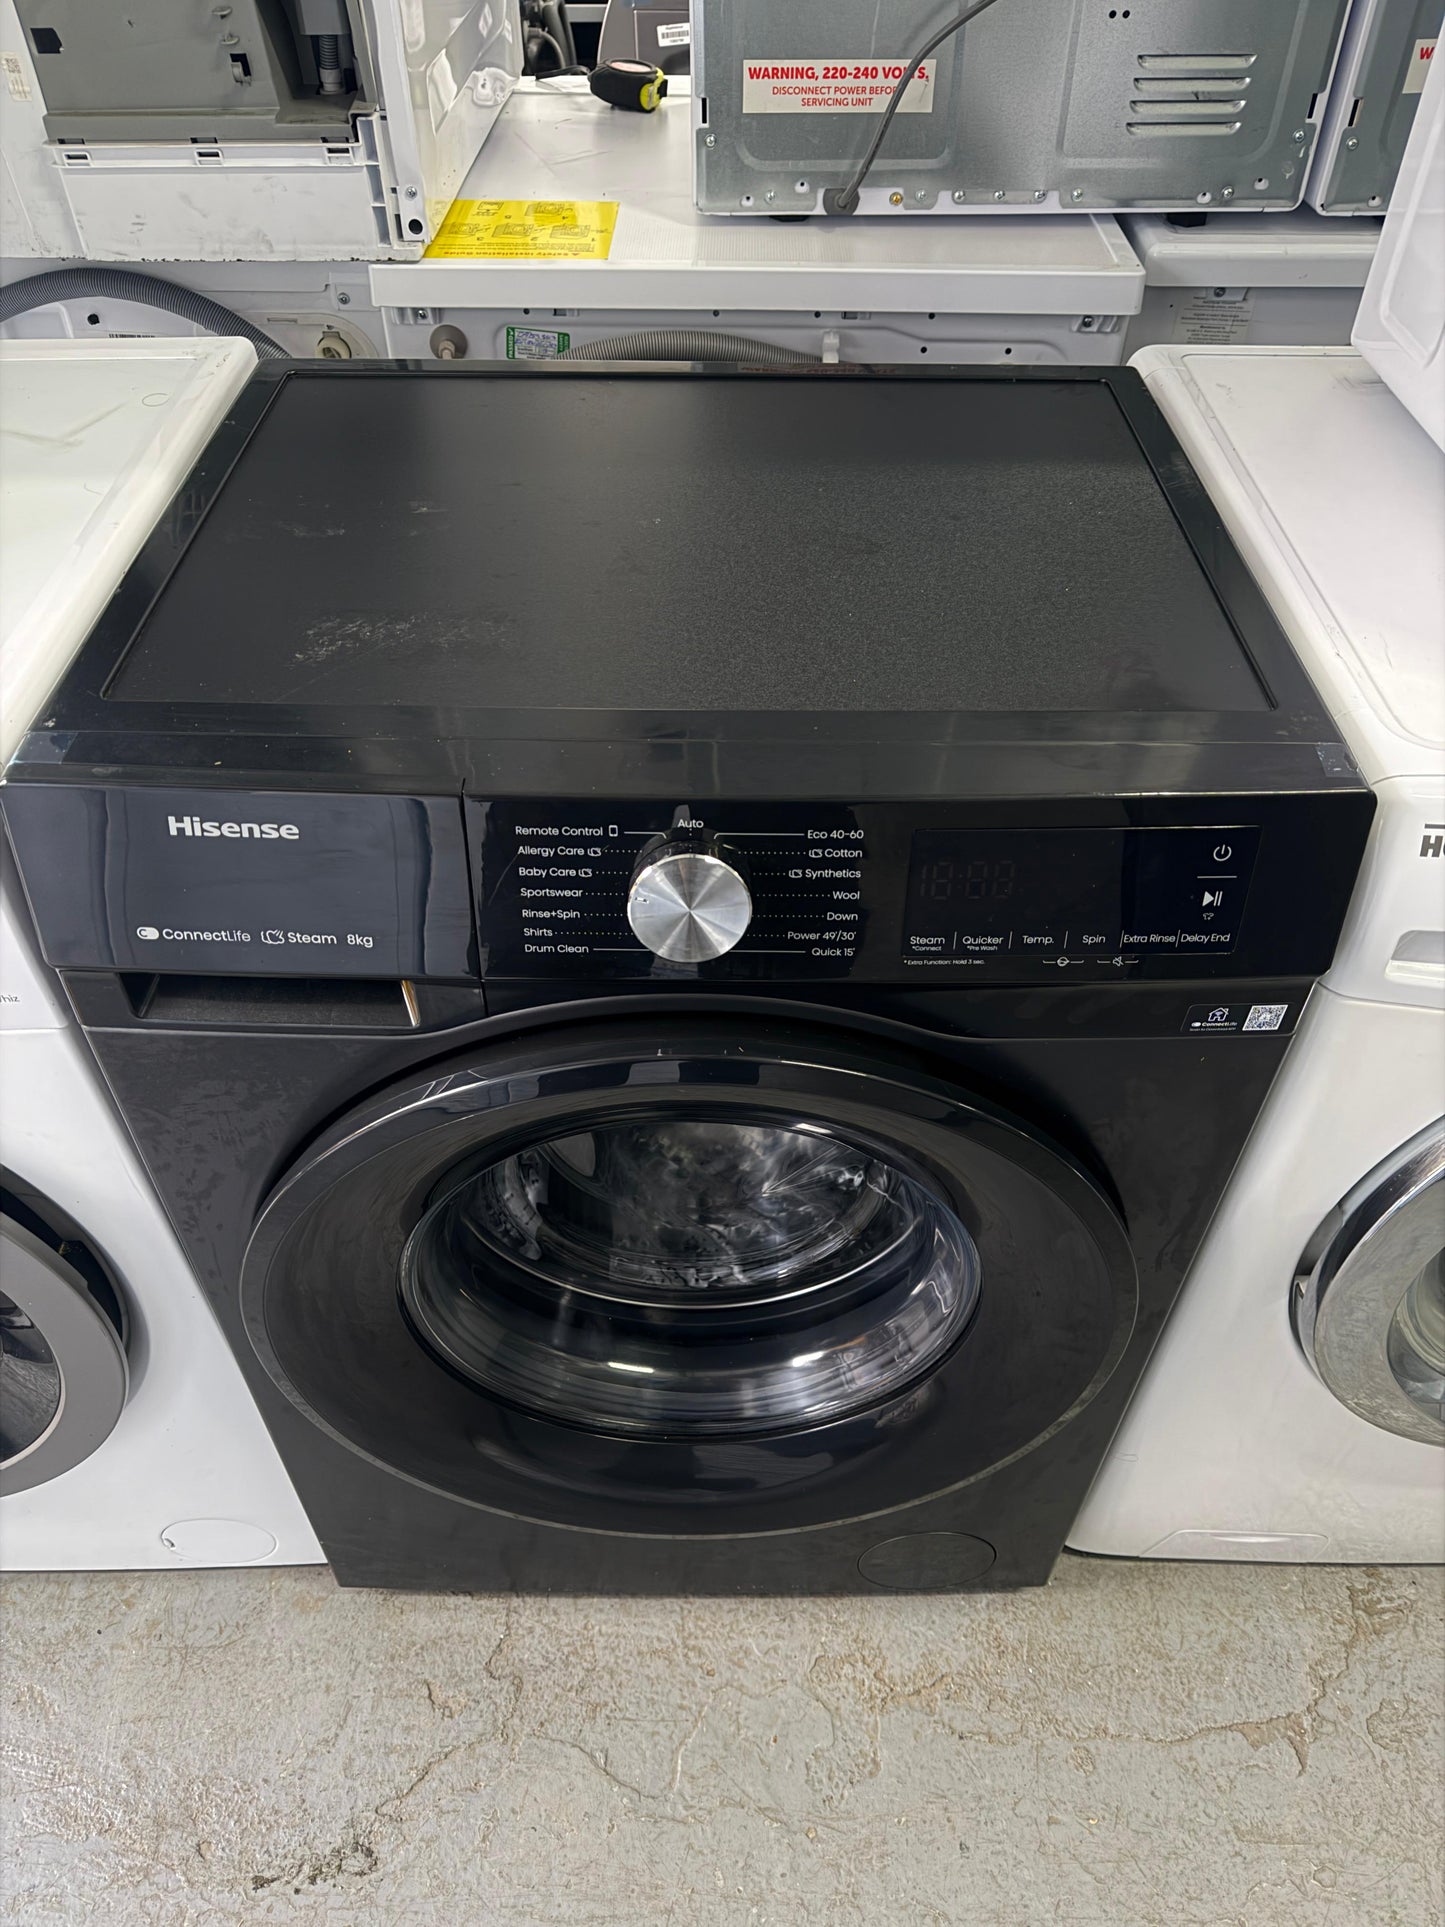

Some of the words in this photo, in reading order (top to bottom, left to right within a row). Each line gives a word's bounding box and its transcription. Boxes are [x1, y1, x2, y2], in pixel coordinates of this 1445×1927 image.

[748, 67, 819, 81] WARNING,
[823, 67, 878, 79] 220-240
[882, 66, 929, 79] VOS.
[772, 86, 832, 95] DISCONNECT
[834, 86, 866, 95] POWER
[870, 86, 897, 95] BEFO
[802, 98, 849, 106] SERVICING
[851, 98, 873, 106] UNIT
[168, 816, 299, 839] Hisense
[678, 819, 703, 828] Auto
[516, 826, 559, 835] Remote
[562, 827, 603, 836] Control
[808, 830, 827, 839] Eco
[830, 830, 864, 839] 40-60
[1419, 834, 1445, 858] H
[517, 846, 555, 857] Allergy
[557, 846, 584, 855] Care
[825, 849, 862, 857] Cotton
[519, 867, 547, 878] Baby
[549, 868, 576, 876] Care
[806, 869, 861, 879] Synthetics
[521, 888, 582, 898] Sportswear
[833, 891, 860, 899] Wool
[522, 909, 580, 920] Rinse+Spin
[827, 912, 858, 920] Down
[524, 928, 552, 936] Shirts
[788, 932, 820, 940] Power
[163, 929, 250, 941] ConnectLife
[288, 932, 337, 944] Steam
[347, 934, 373, 948] 8kg
[910, 936, 945, 944] Steam
[963, 936, 1003, 944] Quicker
[1023, 936, 1054, 945] Temp.
[1083, 935, 1105, 944] Spin
[1124, 935, 1147, 943] Extra
[1150, 934, 1175, 942] Rinse
[1181, 934, 1209, 943] Delay
[1211, 933, 1230, 941] End
[525, 944, 554, 952] Drum
[557, 945, 588, 953] Clean
[812, 948, 841, 956] Quick
